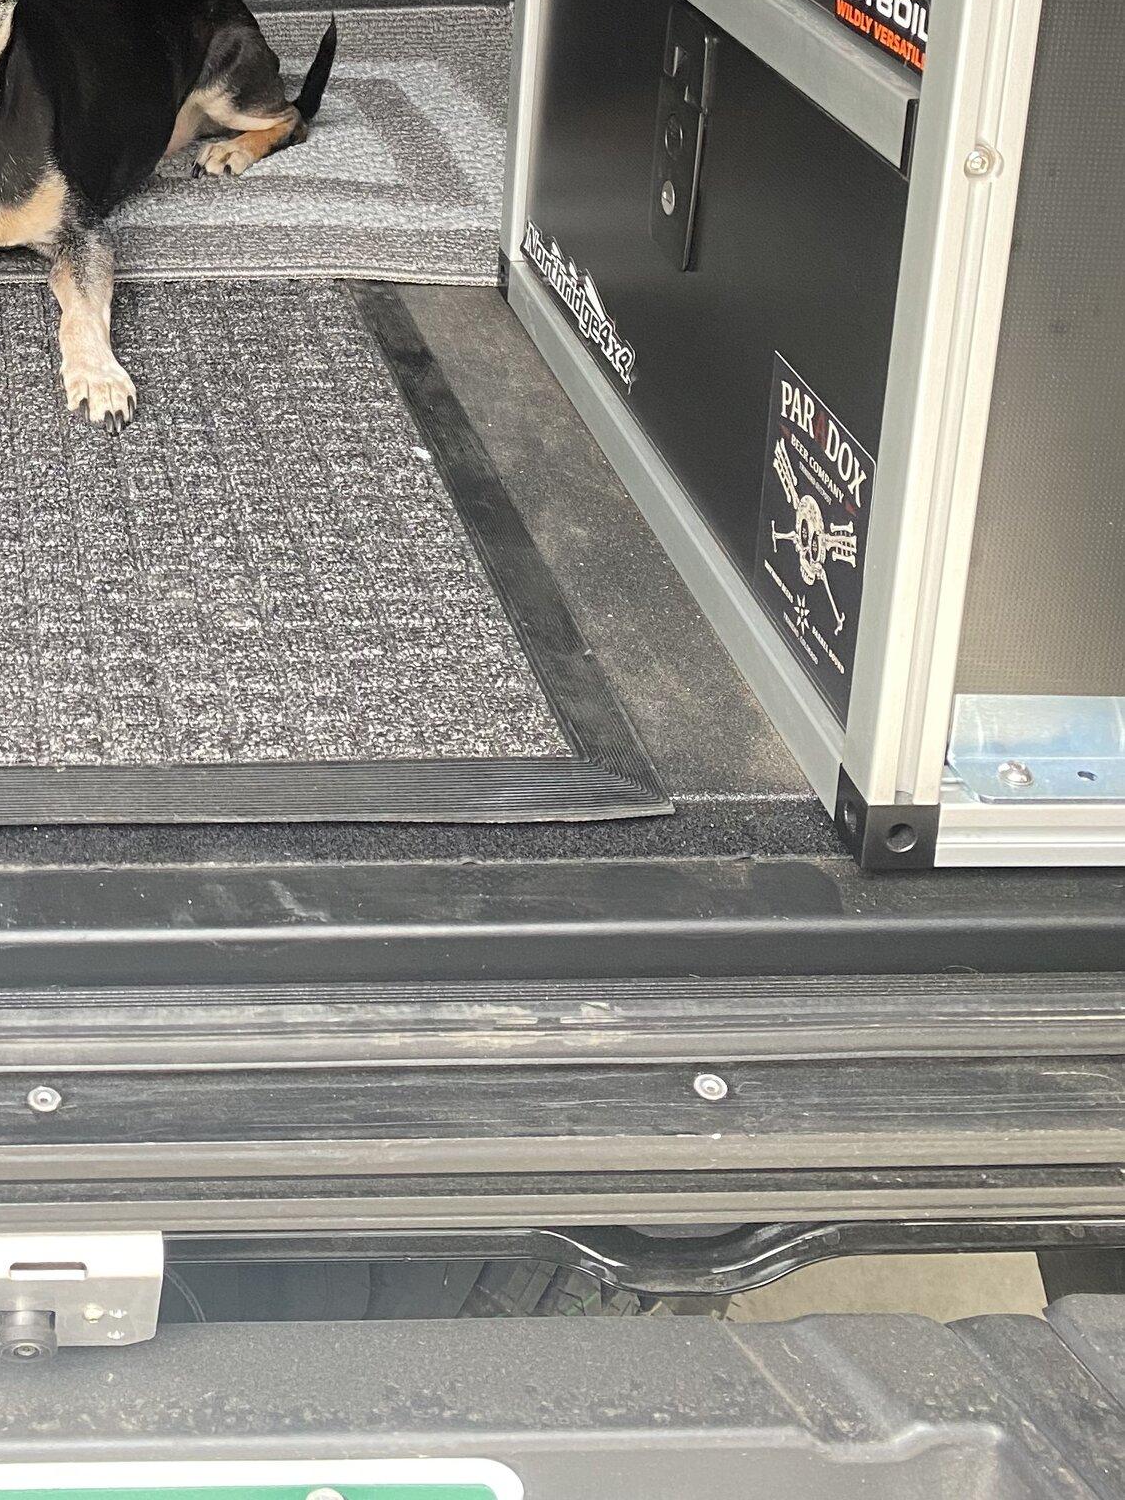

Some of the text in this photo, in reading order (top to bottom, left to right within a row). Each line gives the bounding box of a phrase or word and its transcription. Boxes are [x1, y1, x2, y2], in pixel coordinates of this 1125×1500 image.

[780, 380, 867, 509] PARADOX
[790, 433, 809, 463] BEER
[809, 456, 845, 504] COMPANY
